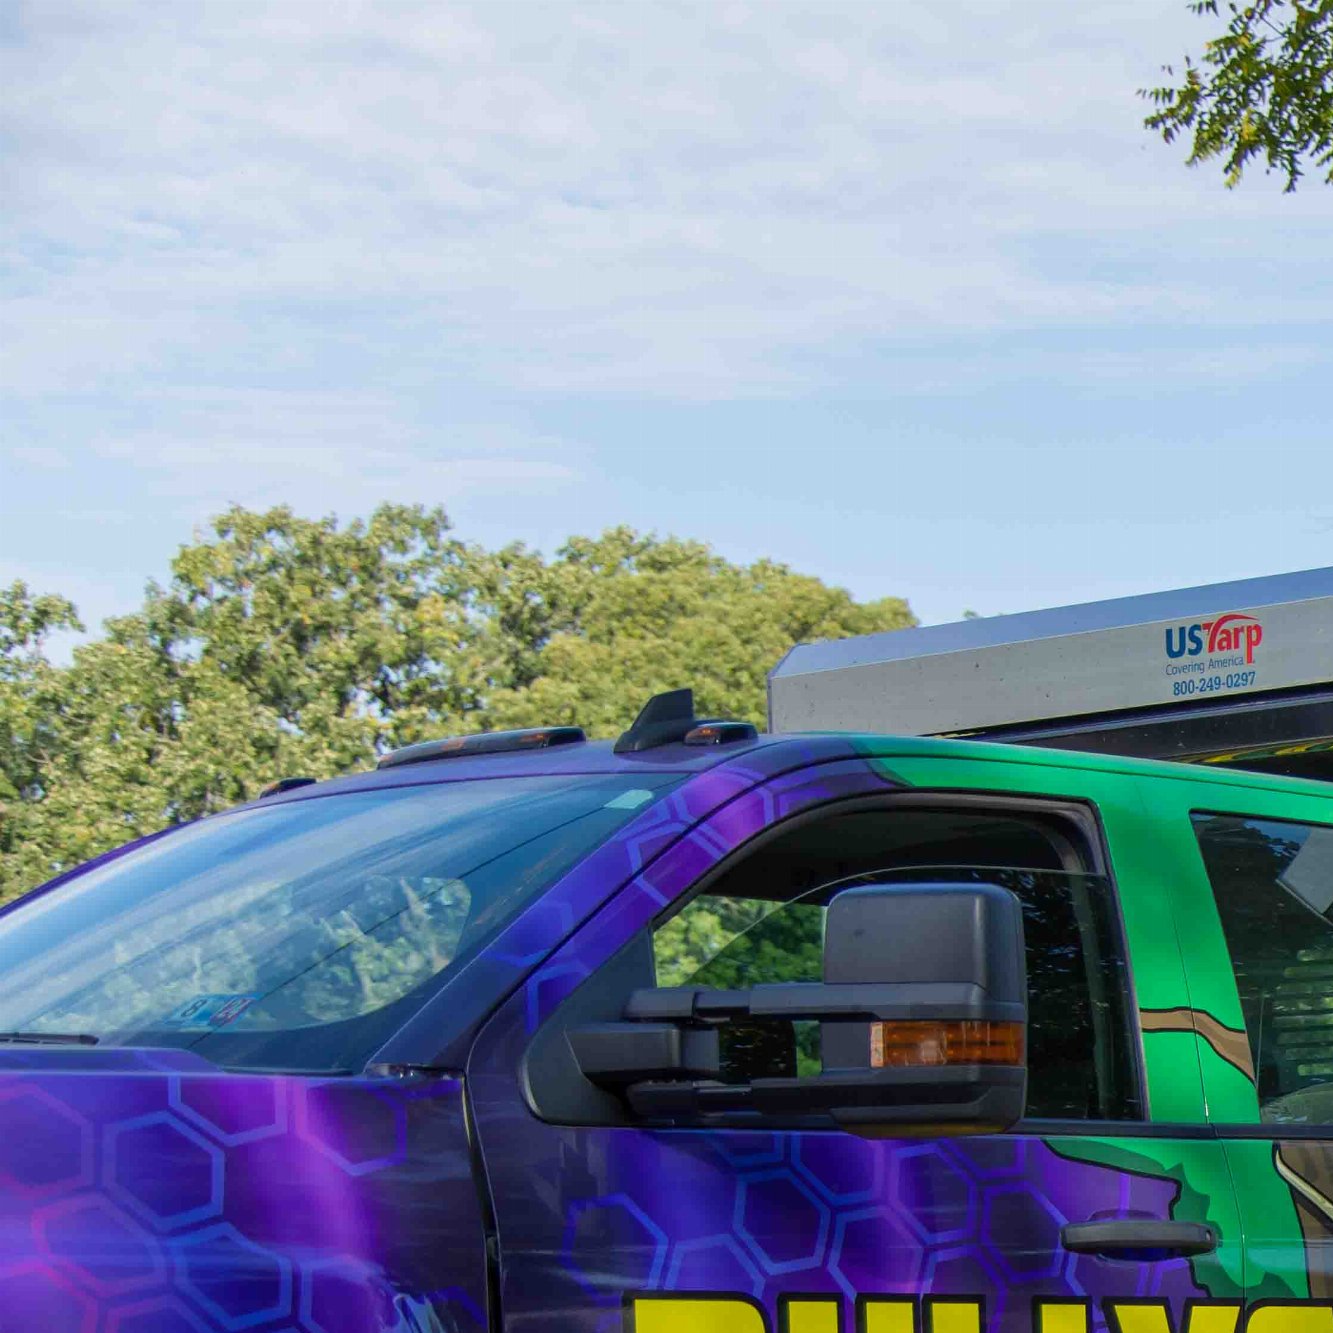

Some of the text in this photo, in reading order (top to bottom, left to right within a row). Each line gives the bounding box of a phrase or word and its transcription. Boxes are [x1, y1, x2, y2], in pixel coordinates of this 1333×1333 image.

[1166, 656, 1244, 676] Covering America
[1173, 671, 1256, 696] 800-249-0297
